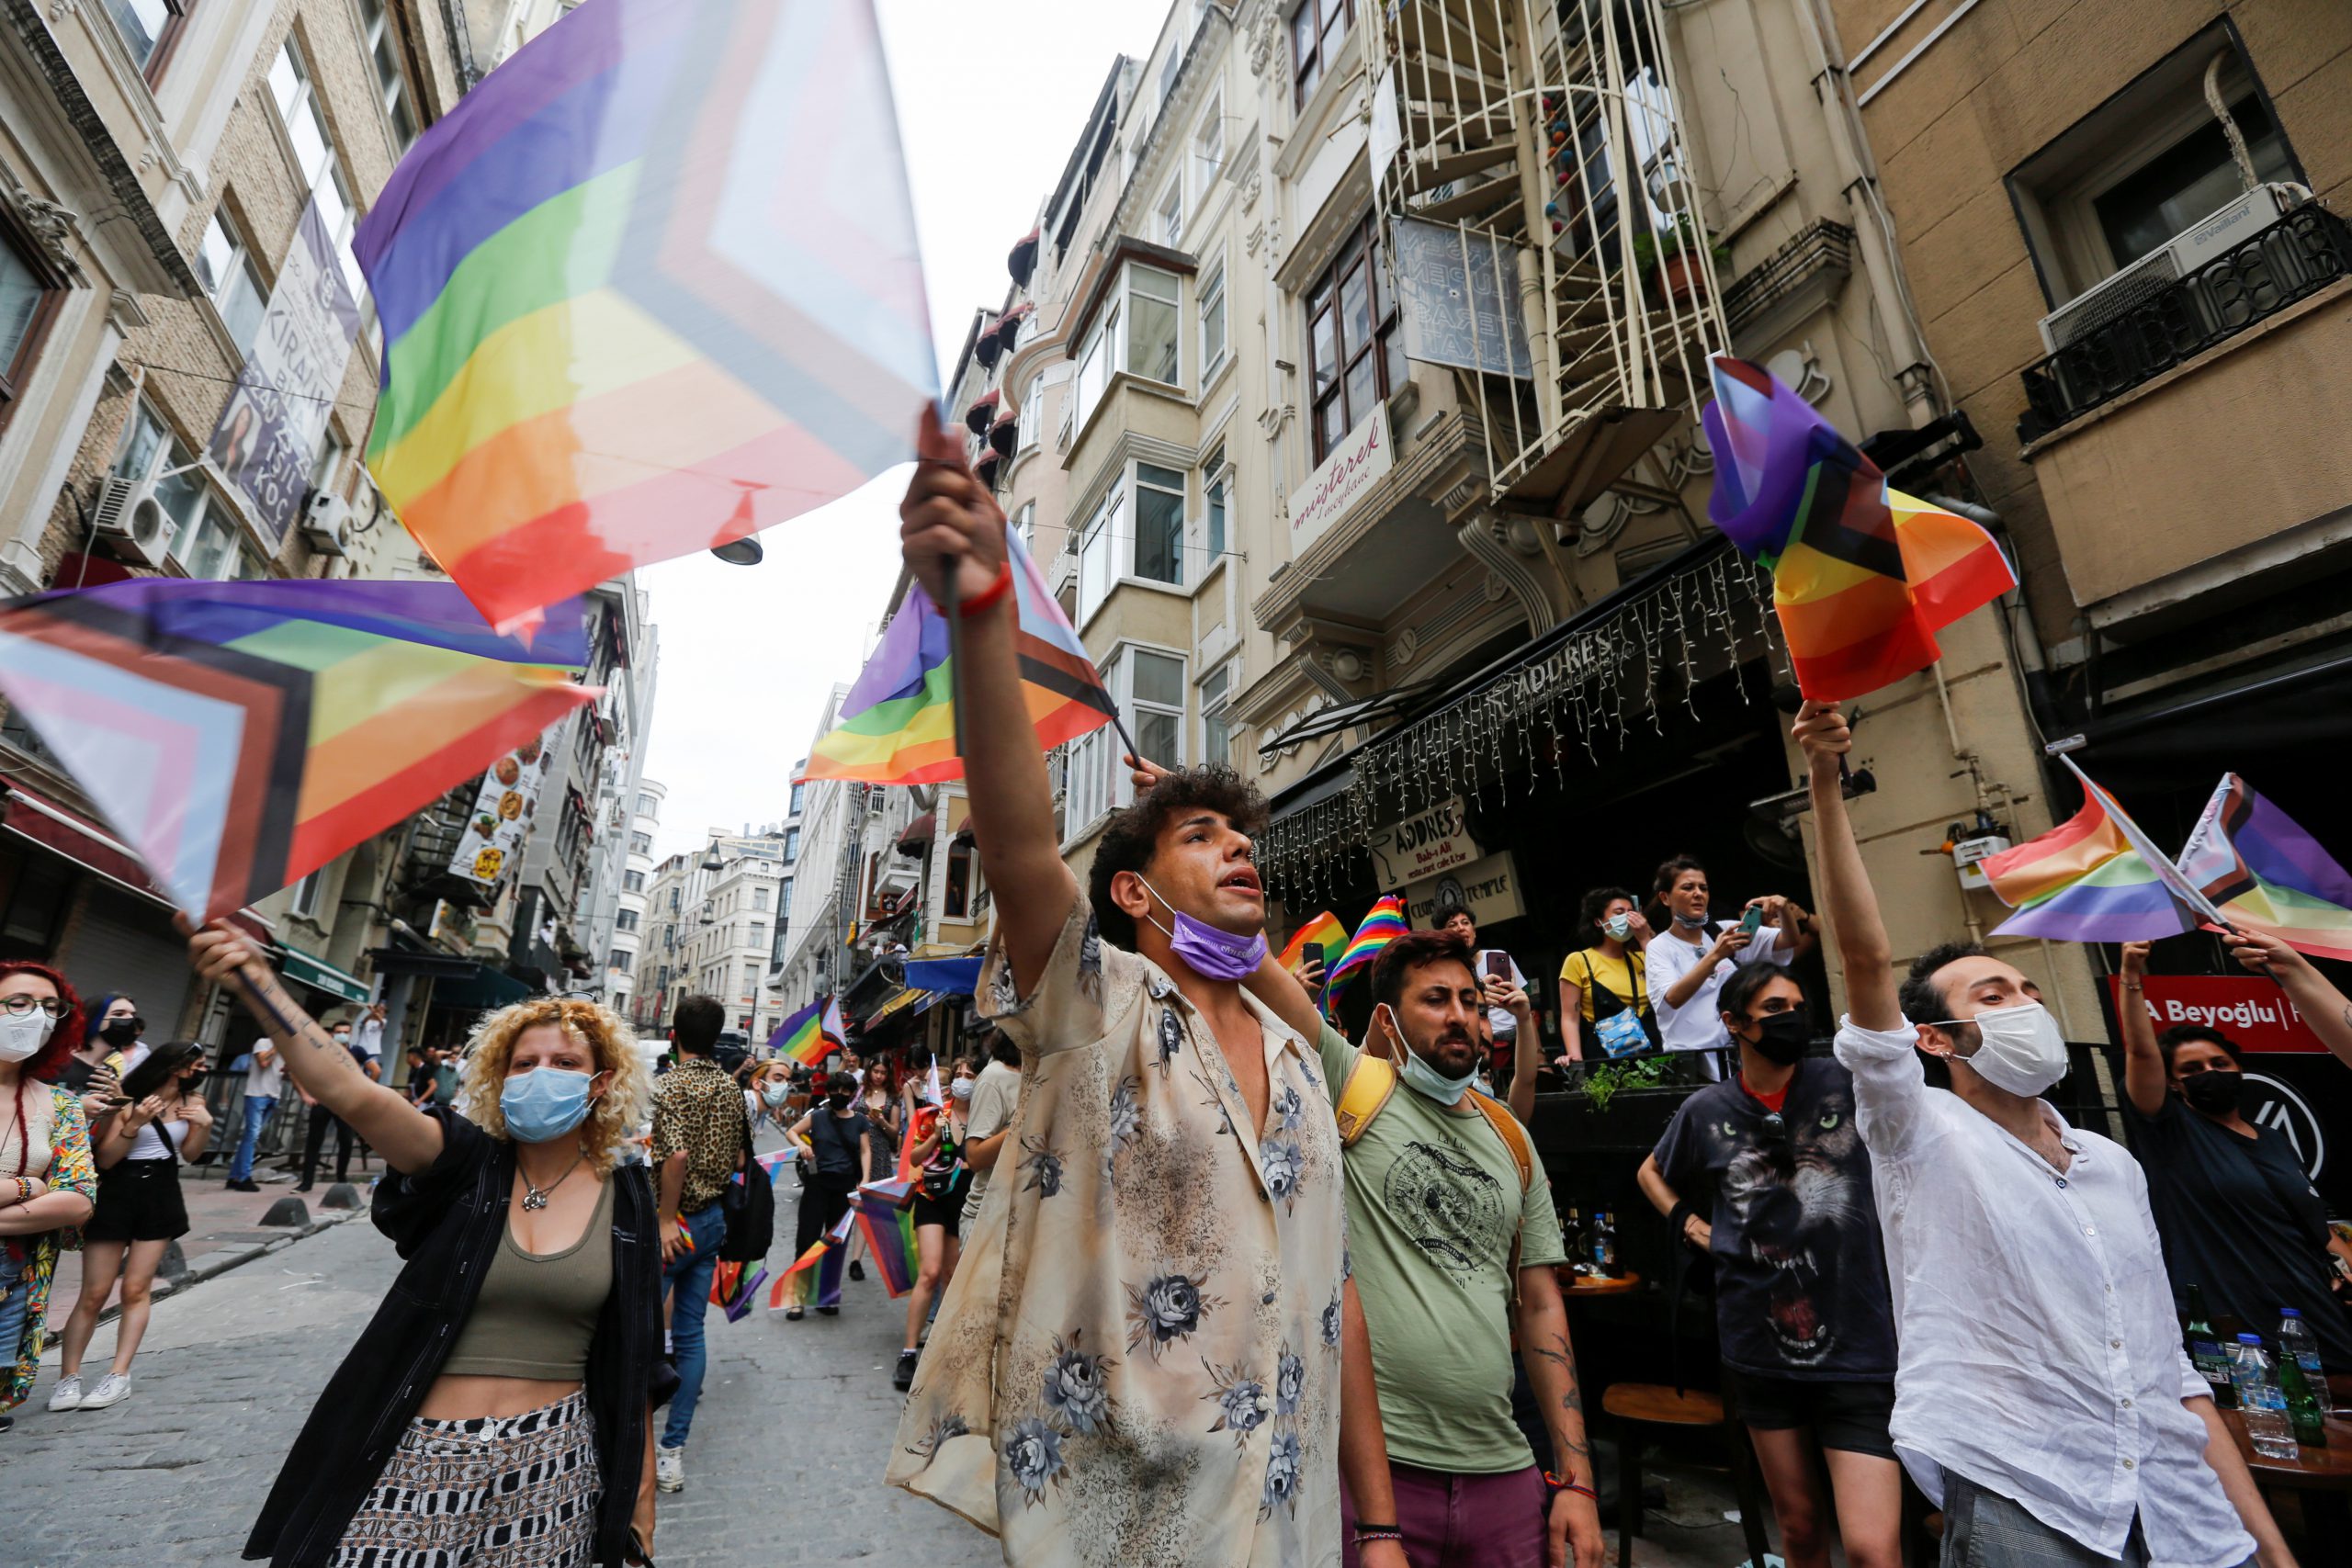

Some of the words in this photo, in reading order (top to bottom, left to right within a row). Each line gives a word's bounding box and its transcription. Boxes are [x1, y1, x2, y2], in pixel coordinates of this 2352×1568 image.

[2206, 206, 2250, 237] Vaillant
[253, 465, 288, 525] KOÇ
[1440, 840, 1452, 855] Ali
[1465, 874, 1510, 903] TEMPLE
[2165, 999, 2277, 1029] Beyoğlu
